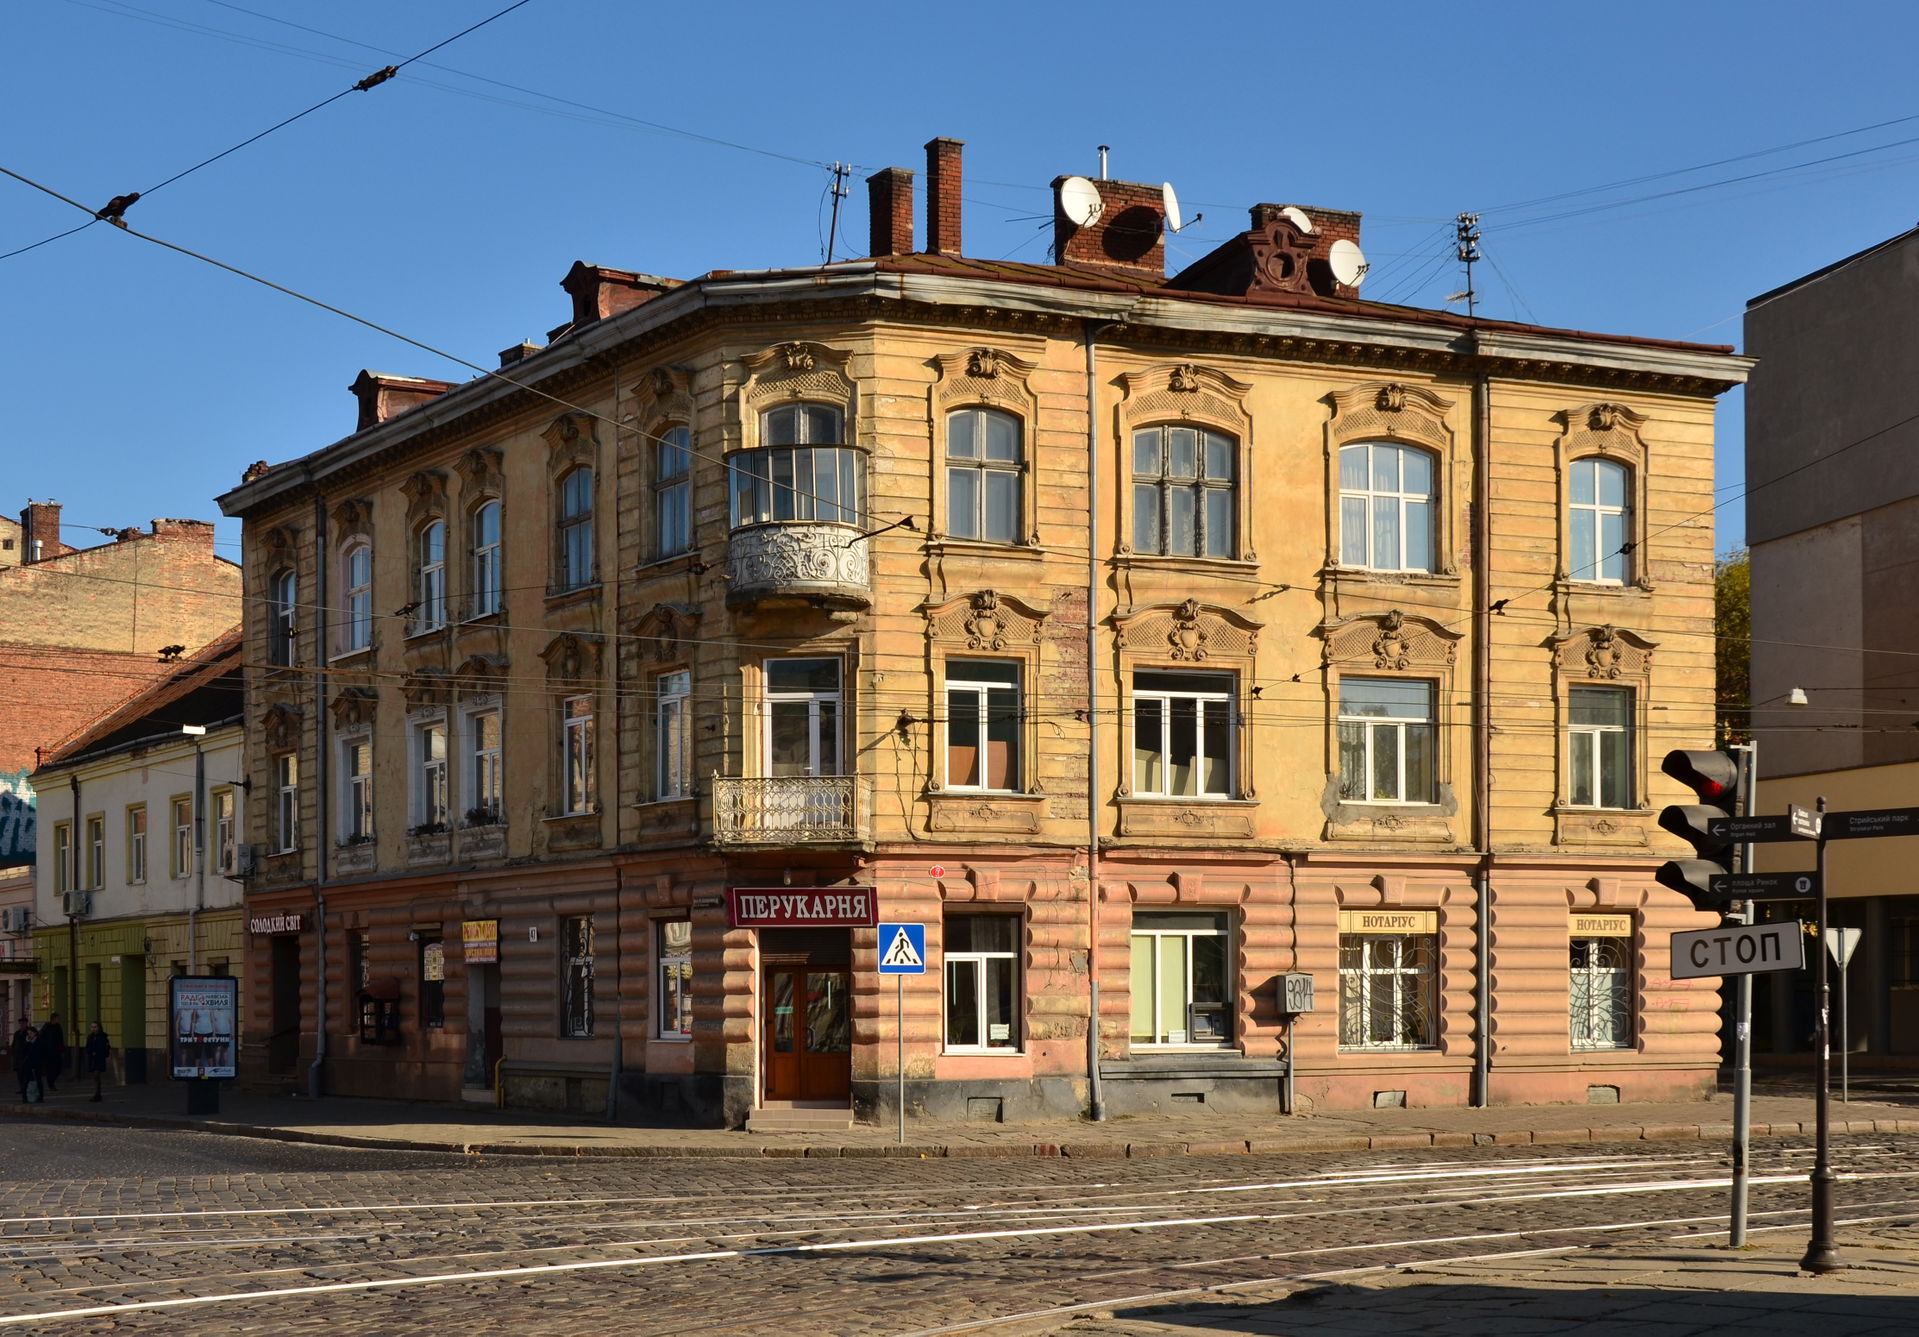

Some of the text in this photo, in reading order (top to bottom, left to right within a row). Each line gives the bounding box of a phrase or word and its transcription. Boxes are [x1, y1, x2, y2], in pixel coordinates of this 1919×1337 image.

[740, 895, 867, 919] ПЕРУКАРНЯ
[250, 913, 301, 934] СОЛОДКИЙ СВІТ
[1362, 915, 1416, 928] НОТАРІУС
[1576, 919, 1627, 932] НОТАРІУС
[1690, 932, 1781, 968] СТОП
